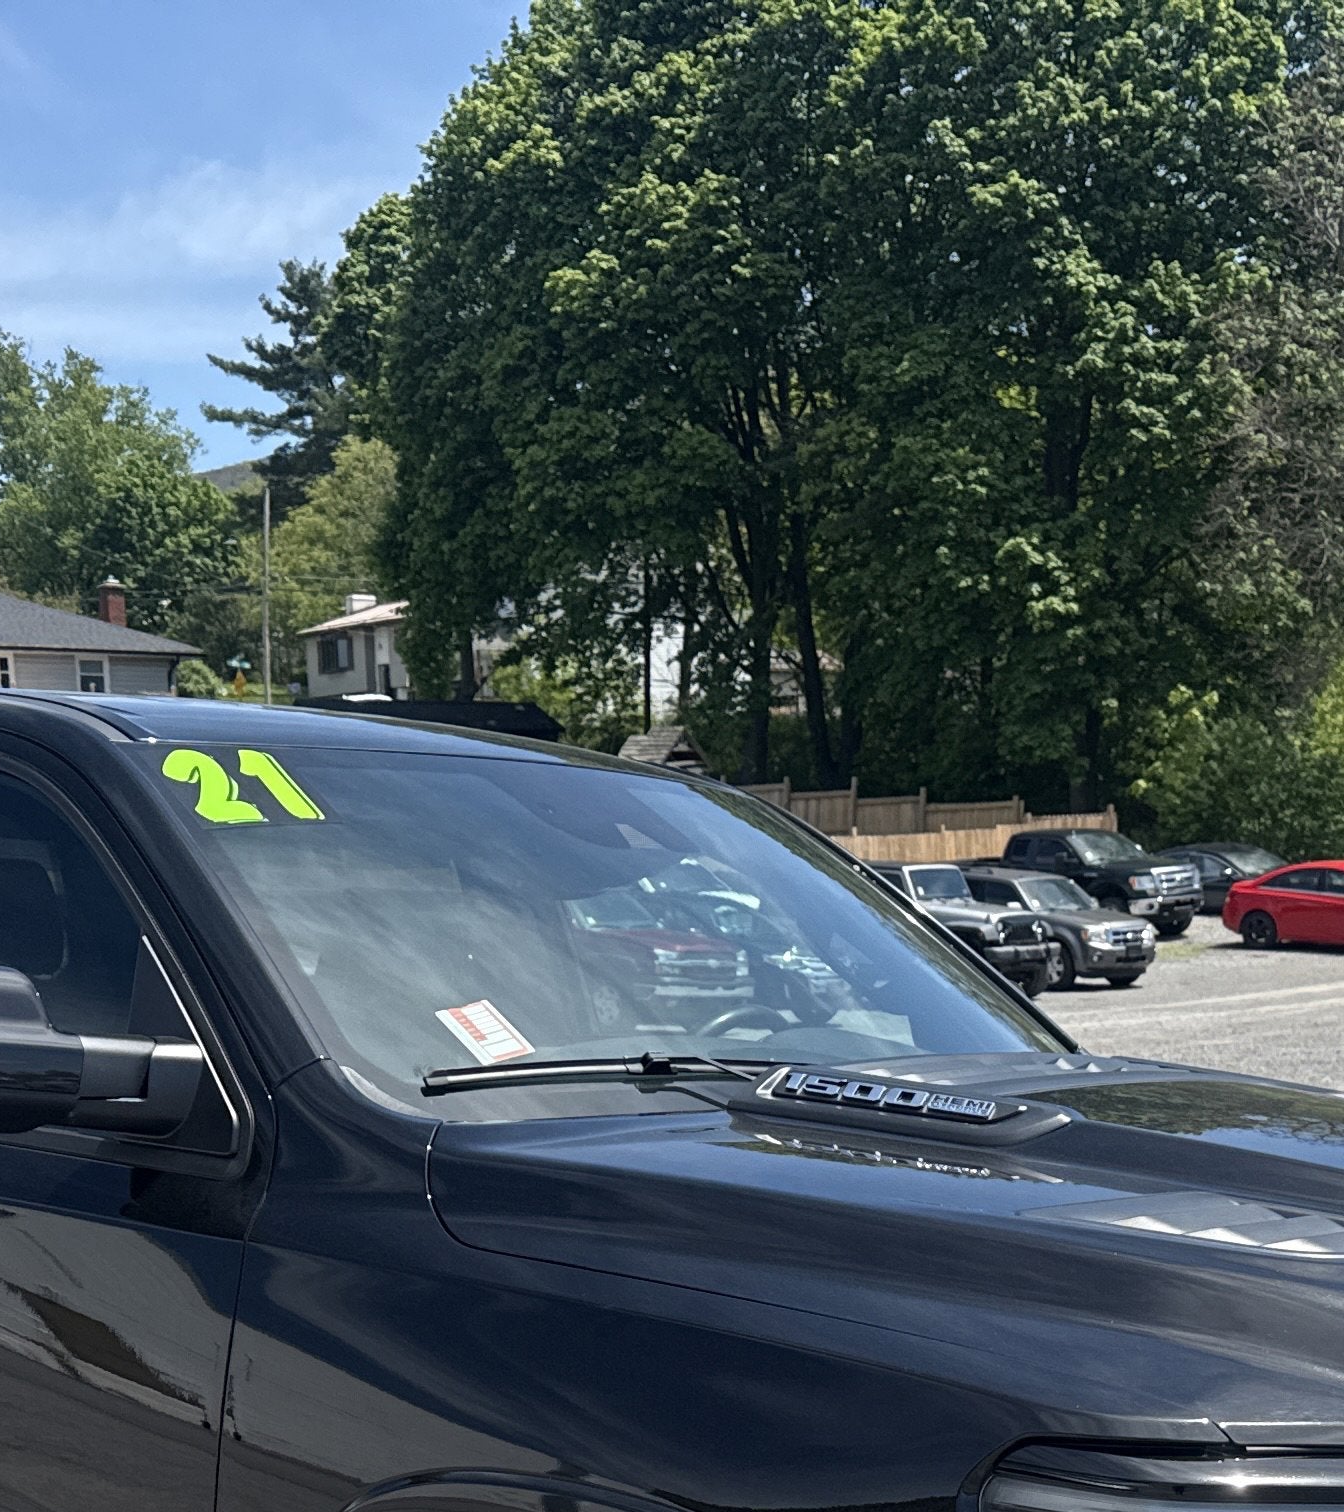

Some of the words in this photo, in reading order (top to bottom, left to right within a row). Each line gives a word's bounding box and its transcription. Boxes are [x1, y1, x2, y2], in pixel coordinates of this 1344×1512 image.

[162, 748, 326, 824] 21
[784, 1071, 931, 1109] 1500
[933, 1094, 992, 1110] HEMI
